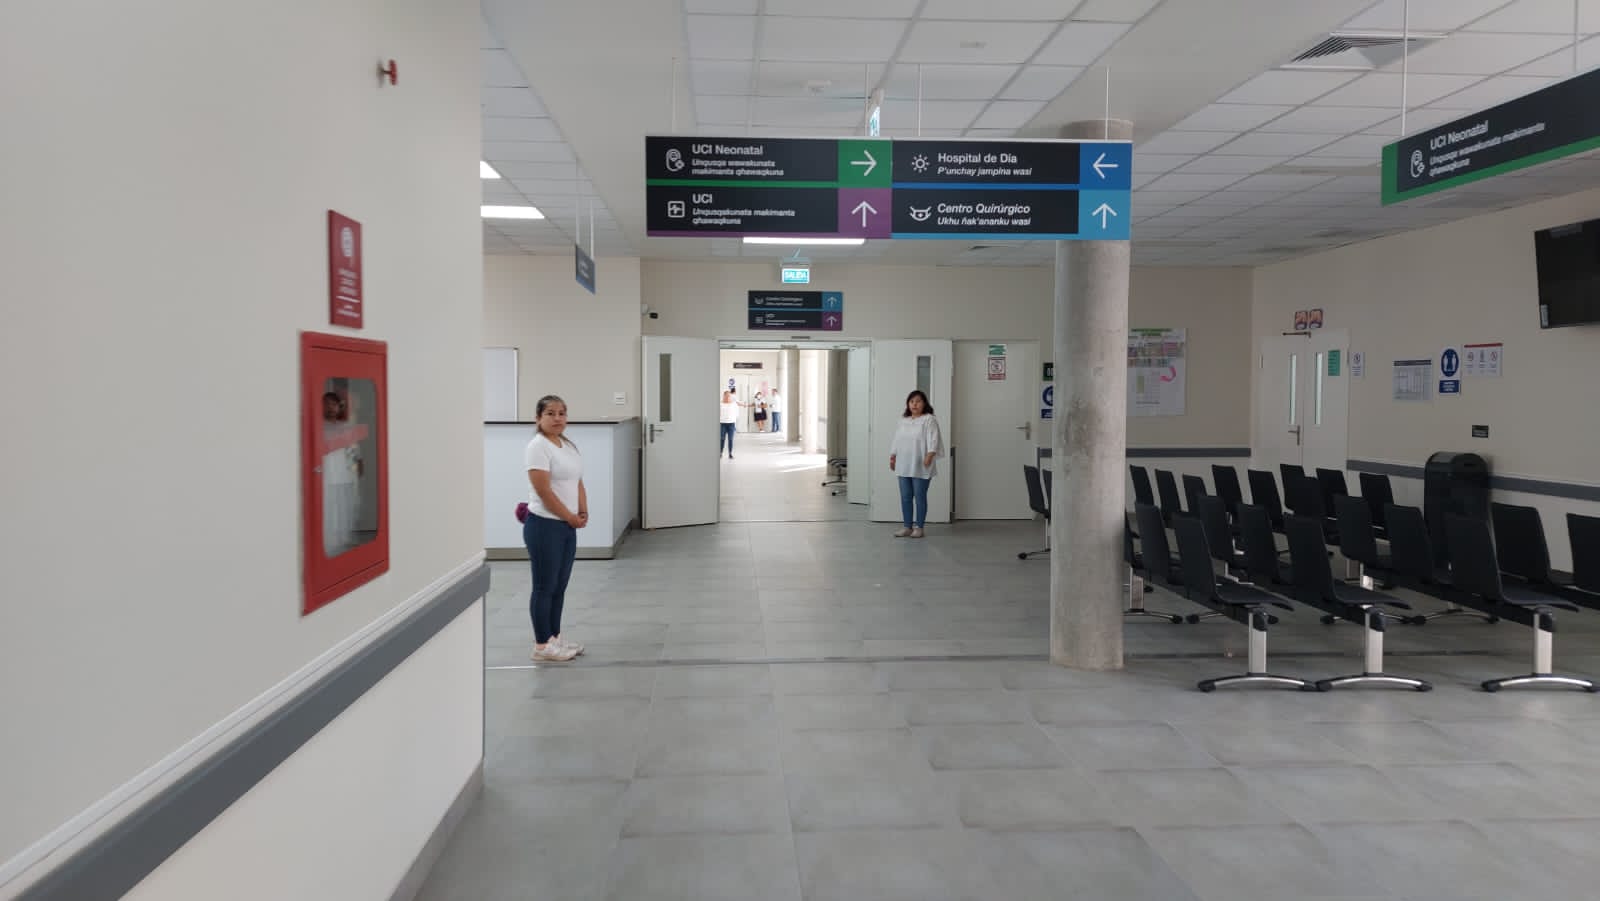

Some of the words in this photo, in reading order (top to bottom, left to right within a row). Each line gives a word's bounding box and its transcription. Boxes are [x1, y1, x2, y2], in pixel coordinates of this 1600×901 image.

[1429, 134, 1447, 150] UCI
[1447, 120, 1489, 145] Neonatal
[692, 144, 713, 154] UCI
[715, 145, 764, 155] Neonatal
[938, 152, 981, 164] Hospital
[984, 153, 997, 163] de
[1000, 153, 1017, 163] Día
[937, 166, 977, 177] P'unchay
[977, 167, 1011, 177] jampina
[1013, 167, 1032, 176] wasi
[692, 194, 713, 204] UCI
[937, 203, 973, 213] Centro
[975, 203, 1031, 215] Quirúrgico
[937, 217, 960, 225] Ukhu
[1011, 217, 1032, 226] wasi
